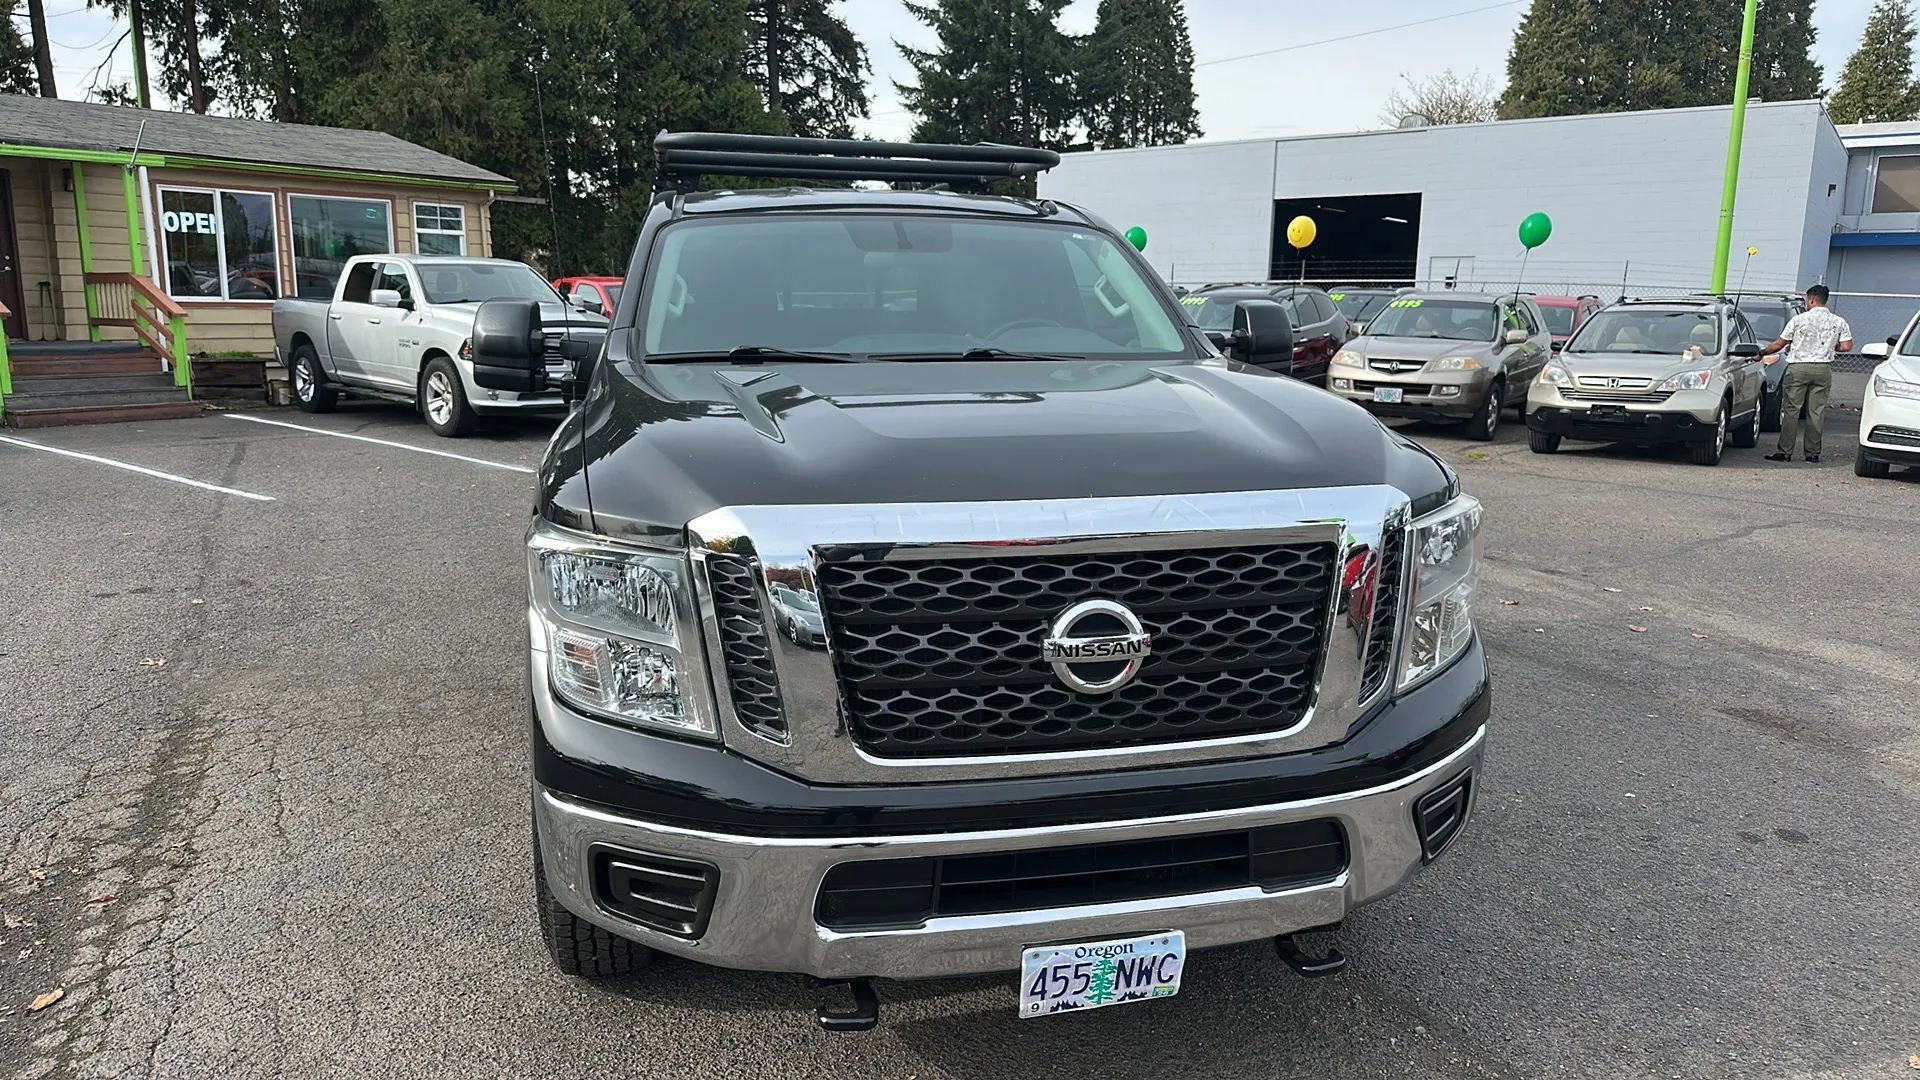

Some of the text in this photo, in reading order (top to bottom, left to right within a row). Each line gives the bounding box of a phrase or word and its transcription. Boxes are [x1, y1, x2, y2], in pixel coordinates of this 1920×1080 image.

[1056, 640, 1141, 658] NISSAN
[1074, 943, 1134, 959] Oregon
[1029, 953, 1178, 1000] 455 NWC
[1031, 1003, 1040, 1013] 9
